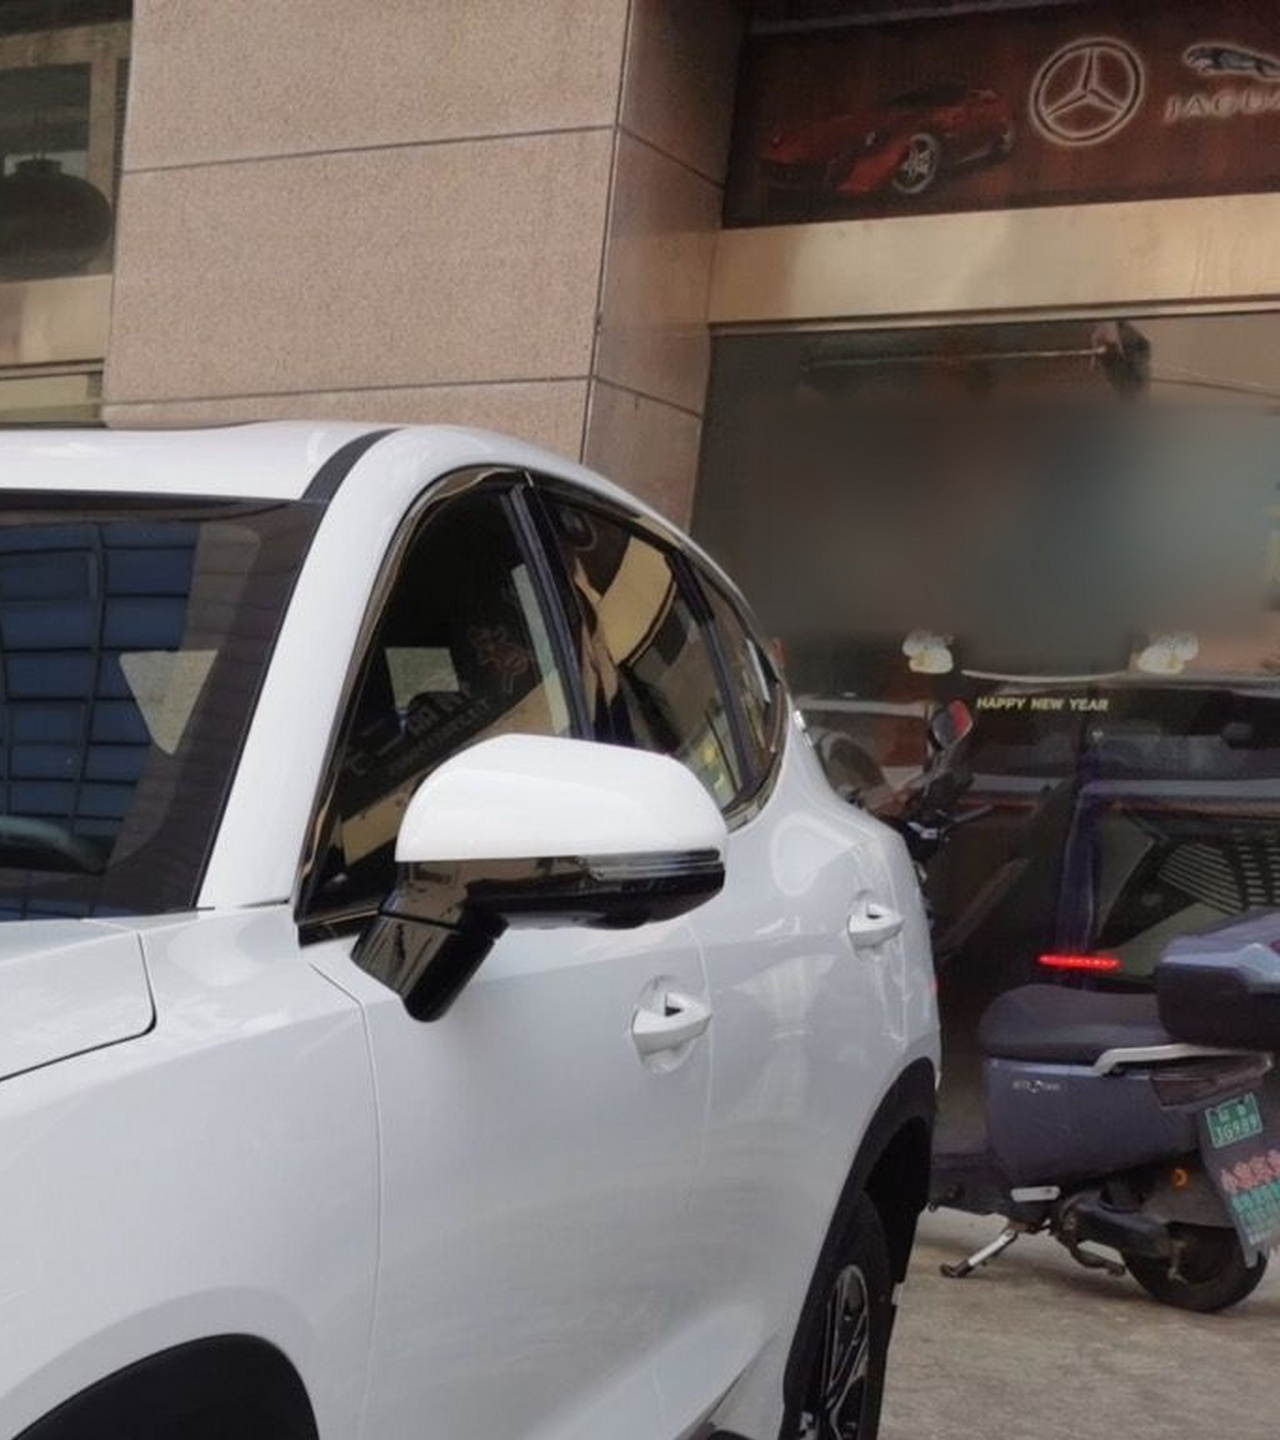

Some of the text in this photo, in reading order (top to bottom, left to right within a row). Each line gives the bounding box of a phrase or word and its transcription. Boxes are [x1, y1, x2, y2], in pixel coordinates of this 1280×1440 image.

[977, 696, 1110, 711] HAPPY NEW YEAR
